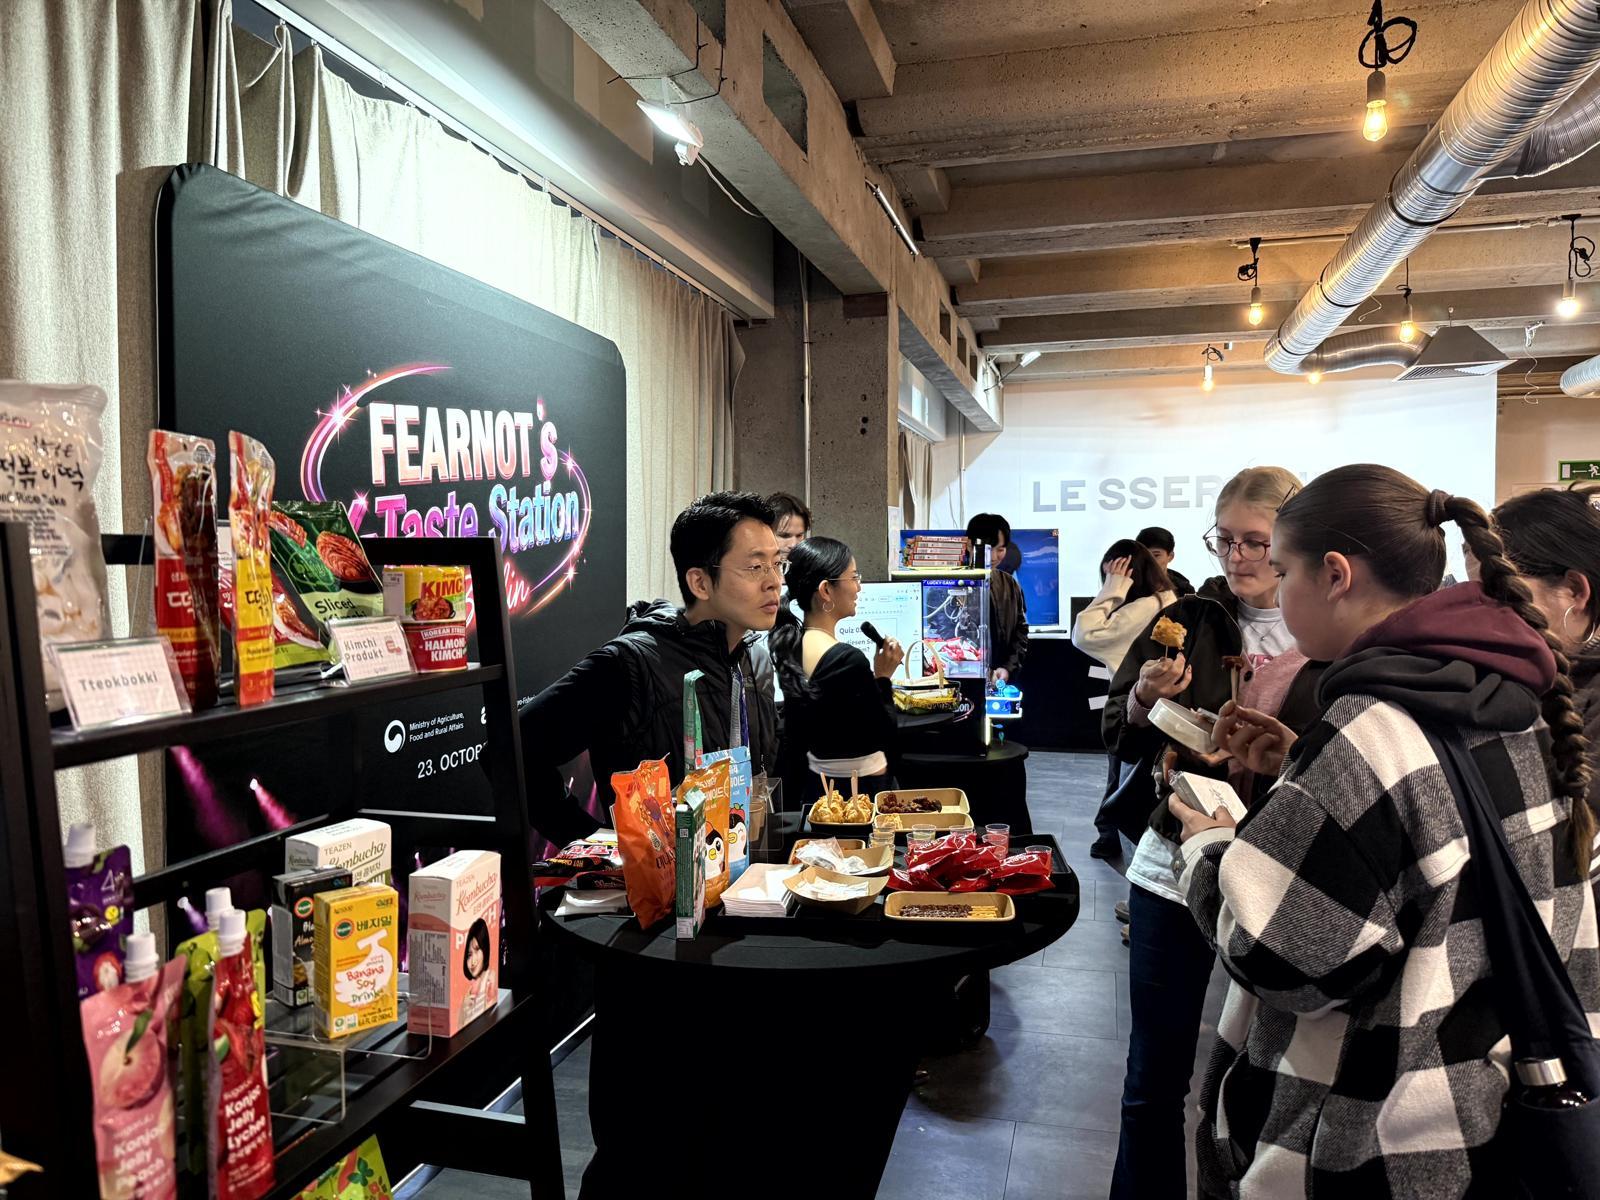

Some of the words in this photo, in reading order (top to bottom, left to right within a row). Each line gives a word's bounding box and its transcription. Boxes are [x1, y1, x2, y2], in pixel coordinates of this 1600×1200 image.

[1033, 480, 1086, 512] LE
[1098, 475, 1221, 511] SSER
[488, 484, 580, 555] Station
[421, 577, 464, 601] KIMC
[315, 598, 356, 614] Sliced
[839, 626, 855, 635] Quiz
[344, 638, 377, 652] Kimchi
[345, 650, 384, 664] Produkt
[431, 649, 464, 662] KIMCHI
[79, 671, 158, 692] Tteokbokki
[409, 720, 430, 732] Ministry
[438, 712, 465, 726] Agriculture,
[409, 734, 424, 743] Food
[425, 730, 434, 739] and
[435, 727, 447, 736] Rural
[448, 722, 464, 733] Affairs
[417, 759, 437, 779] 23.
[324, 841, 352, 856] TEAZEN
[456, 871, 499, 916] Kombucha
[346, 965, 385, 981] Banana
[356, 978, 376, 990] Soy
[227, 1108, 256, 1134] Jelly
[227, 1115, 267, 1151] Lychee
[115, 1148, 153, 1175] Jelly
